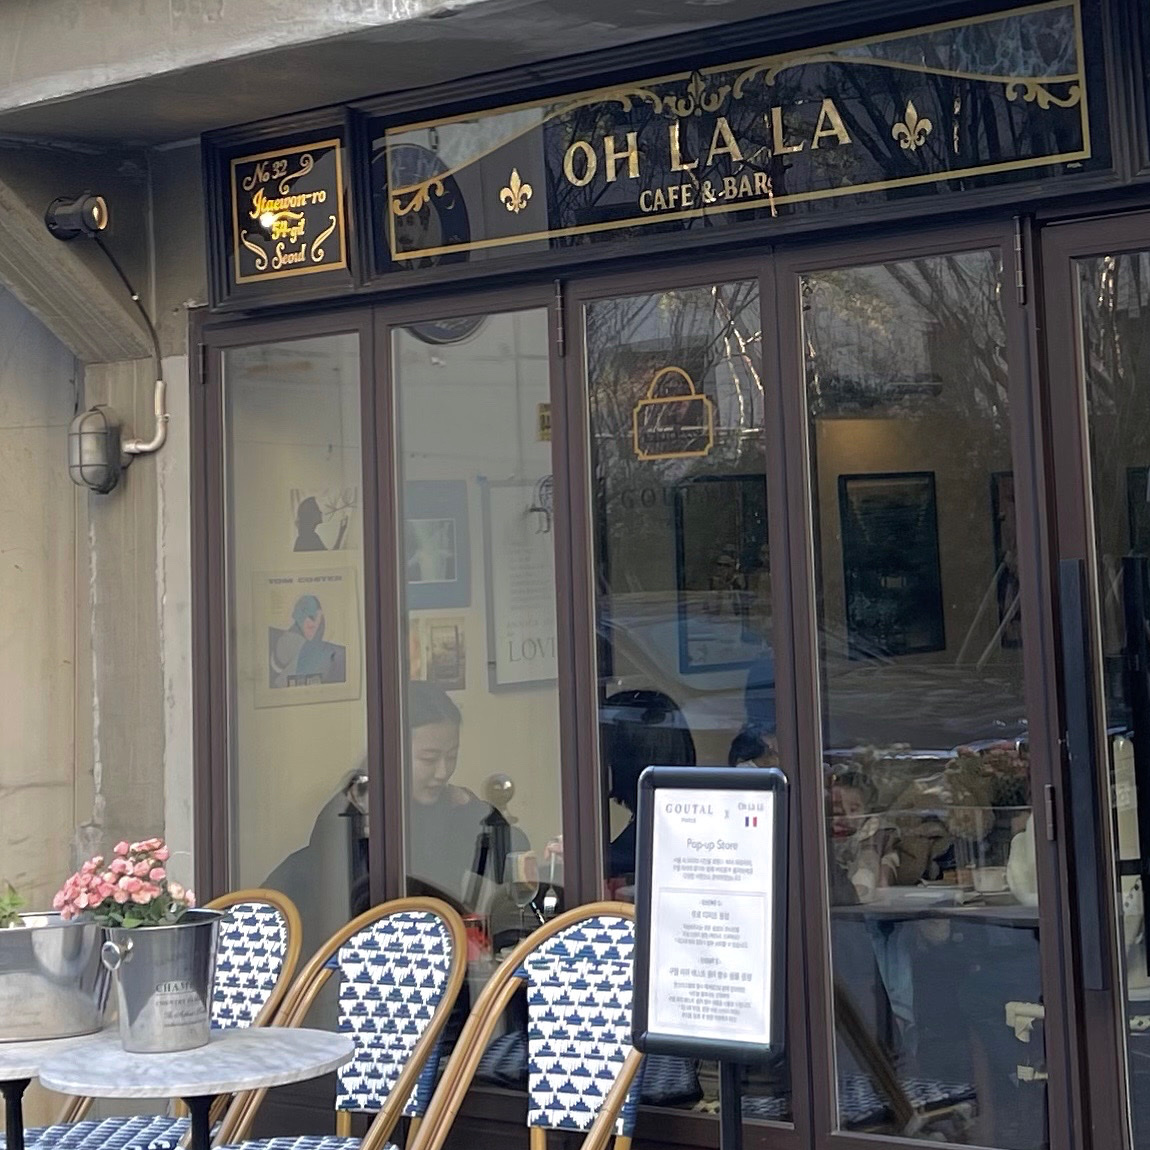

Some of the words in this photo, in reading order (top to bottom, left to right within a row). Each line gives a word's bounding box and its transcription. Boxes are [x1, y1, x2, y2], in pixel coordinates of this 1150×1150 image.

[563, 131, 641, 187] OH
[668, 116, 745, 172] LA
[770, 98, 853, 156] LA
[271, 159, 289, 180] 32
[249, 187, 327, 220] Itaewon-ro
[639, 184, 694, 213] CAFE
[701, 182, 718, 204] &
[722, 171, 772, 201] BAR
[272, 241, 308, 270] Seoul
[665, 803, 714, 816] GOUTAL
[687, 837, 716, 852] Pop-up
[717, 838, 739, 851] Store
